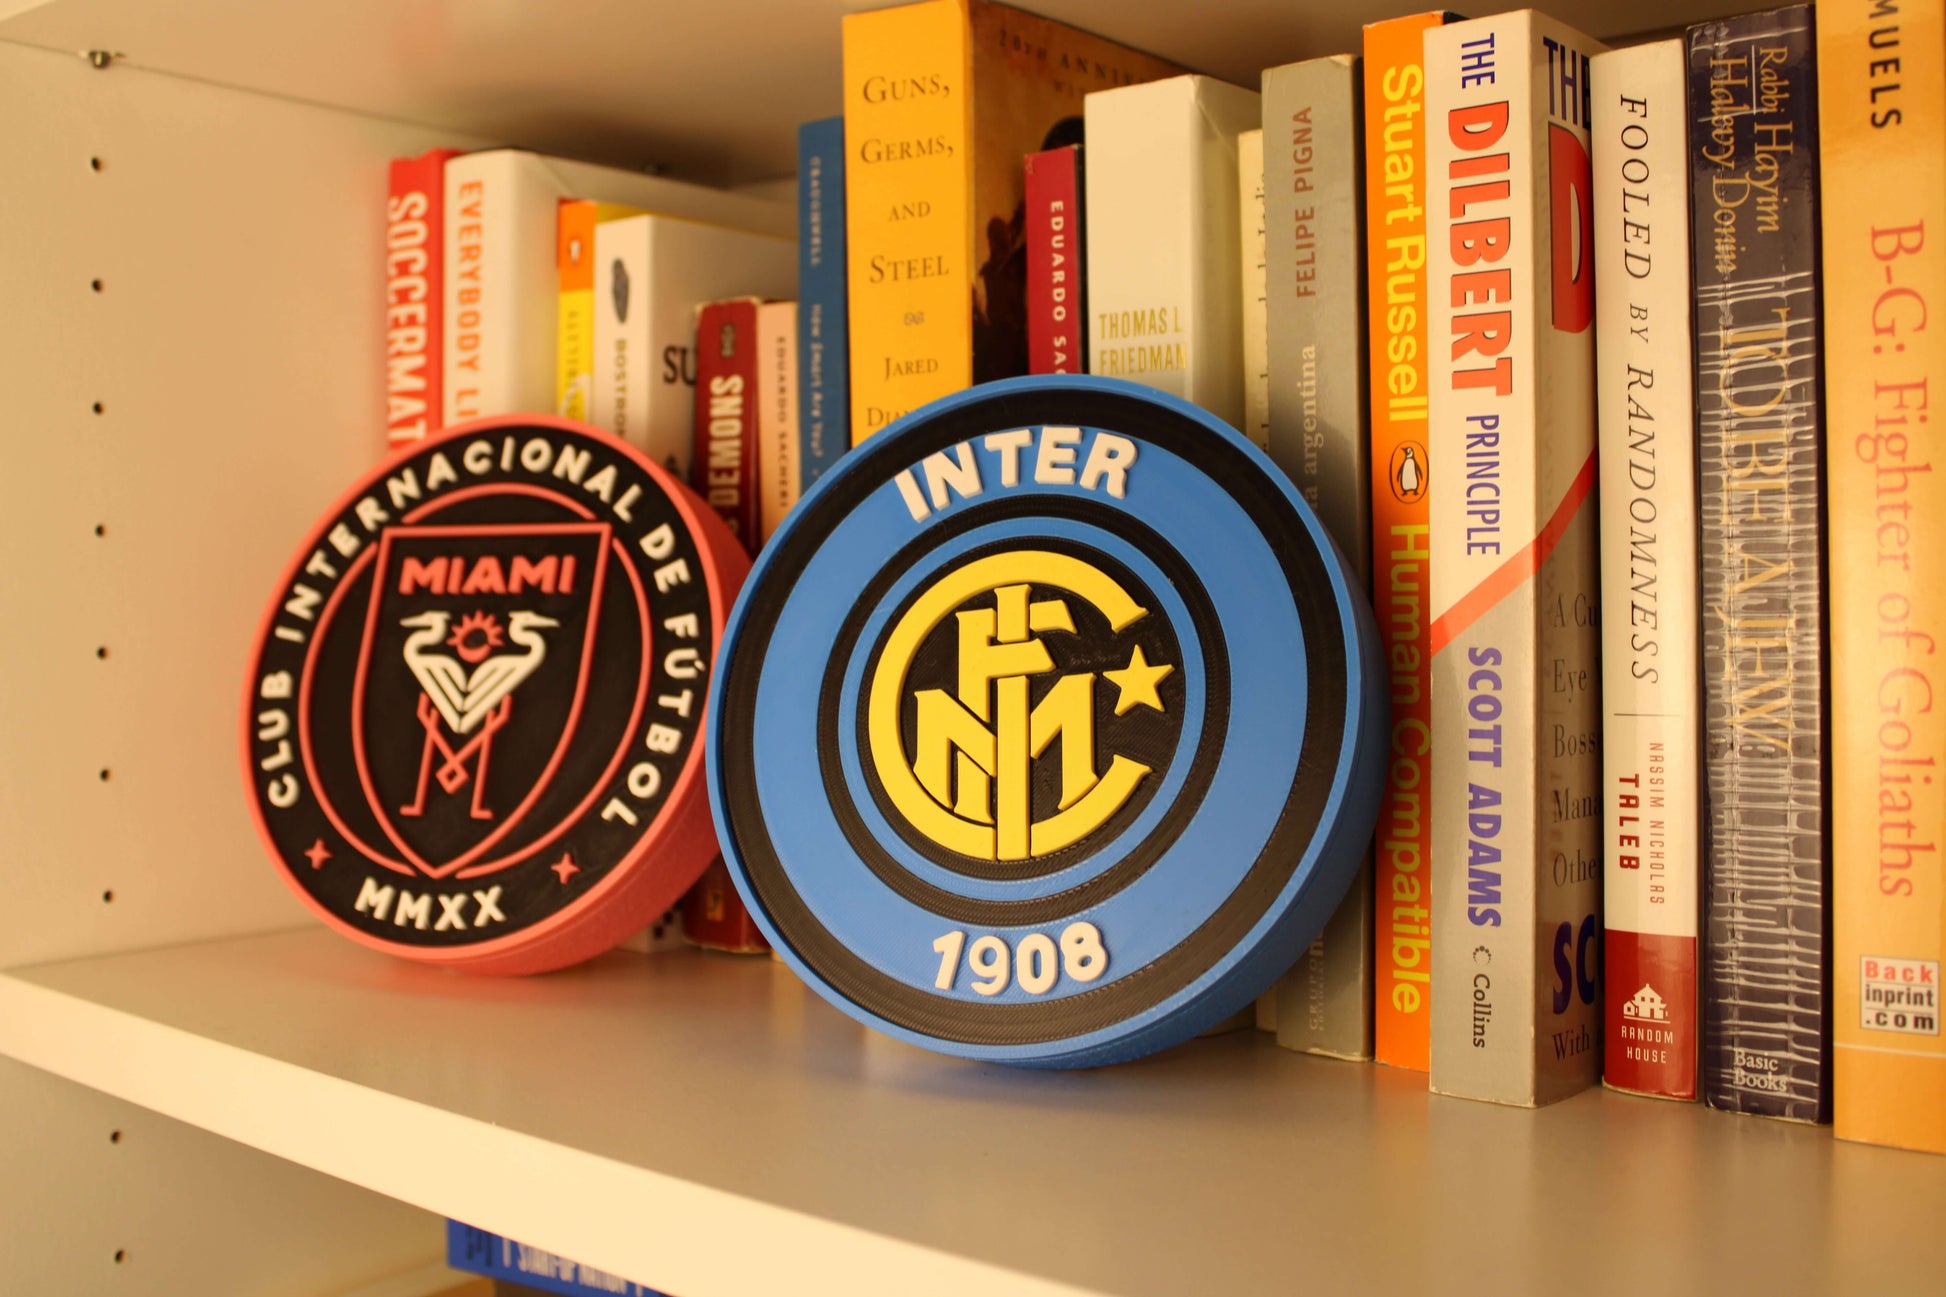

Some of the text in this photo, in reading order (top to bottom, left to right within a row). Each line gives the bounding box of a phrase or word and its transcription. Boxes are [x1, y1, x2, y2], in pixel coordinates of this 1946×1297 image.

[1059, 52, 1146, 85] ANNIV
[1703, 55, 1751, 275] Halevy Donin
[1745, 46, 1794, 234] Rabbi Hayim
[1292, 105, 1317, 298] FELIPE PIGNA
[456, 181, 484, 372] EVERYBODY
[1050, 200, 1067, 322] EDUARDO
[1383, 63, 1428, 422] Stuart Russell
[810, 304, 823, 337] How
[1098, 306, 1168, 340] THOMAS
[1448, 32, 1513, 556] THE DILBERT PRINCIPLE
[810, 342, 823, 388] Smart
[1098, 342, 1187, 376] FRIEDMAN
[1619, 93, 1659, 685] FOOLED BY RANDOMNESS
[708, 373, 744, 507] DEMONS
[776, 336, 789, 508] EDUARDO SACHERI
[810, 391, 823, 418] Are
[866, 406, 909, 427] DIA
[1299, 343, 1325, 478] argentina
[893, 424, 1140, 524] INTER
[1713, 306, 1797, 760] TO BE A JEW
[1854, 217, 1937, 898] B-G: Fighter of Goliaths
[399, 554, 577, 595] MIAMI
[1552, 592, 1567, 629] A
[258, 436, 706, 829] CLUB INTERNACIONAL DE FÚTBOL
[1552, 658, 1588, 703] Eye
[1384, 524, 1431, 1015] Human Compatible
[1467, 646, 1503, 929] SCOTT ADAMS
[1618, 773, 1640, 871] TALEB
[1648, 742, 1665, 905] NASSIM NICHOLAS
[353, 876, 508, 931] MMXX
[932, 920, 1111, 997] 1908
[1552, 913, 1600, 1015] SC
[1864, 959, 1934, 984] Back
[1864, 982, 1936, 1008] inprint
[1472, 972, 1492, 1049] Collins
[1552, 1024, 1591, 1063] With
[1620, 1024, 1674, 1045] RANDOM
[1864, 1010, 1936, 1031] .com
[1626, 1045, 1668, 1064] HOUSE
[1732, 1048, 1779, 1071] Basic
[1732, 1069, 1788, 1094] Books
